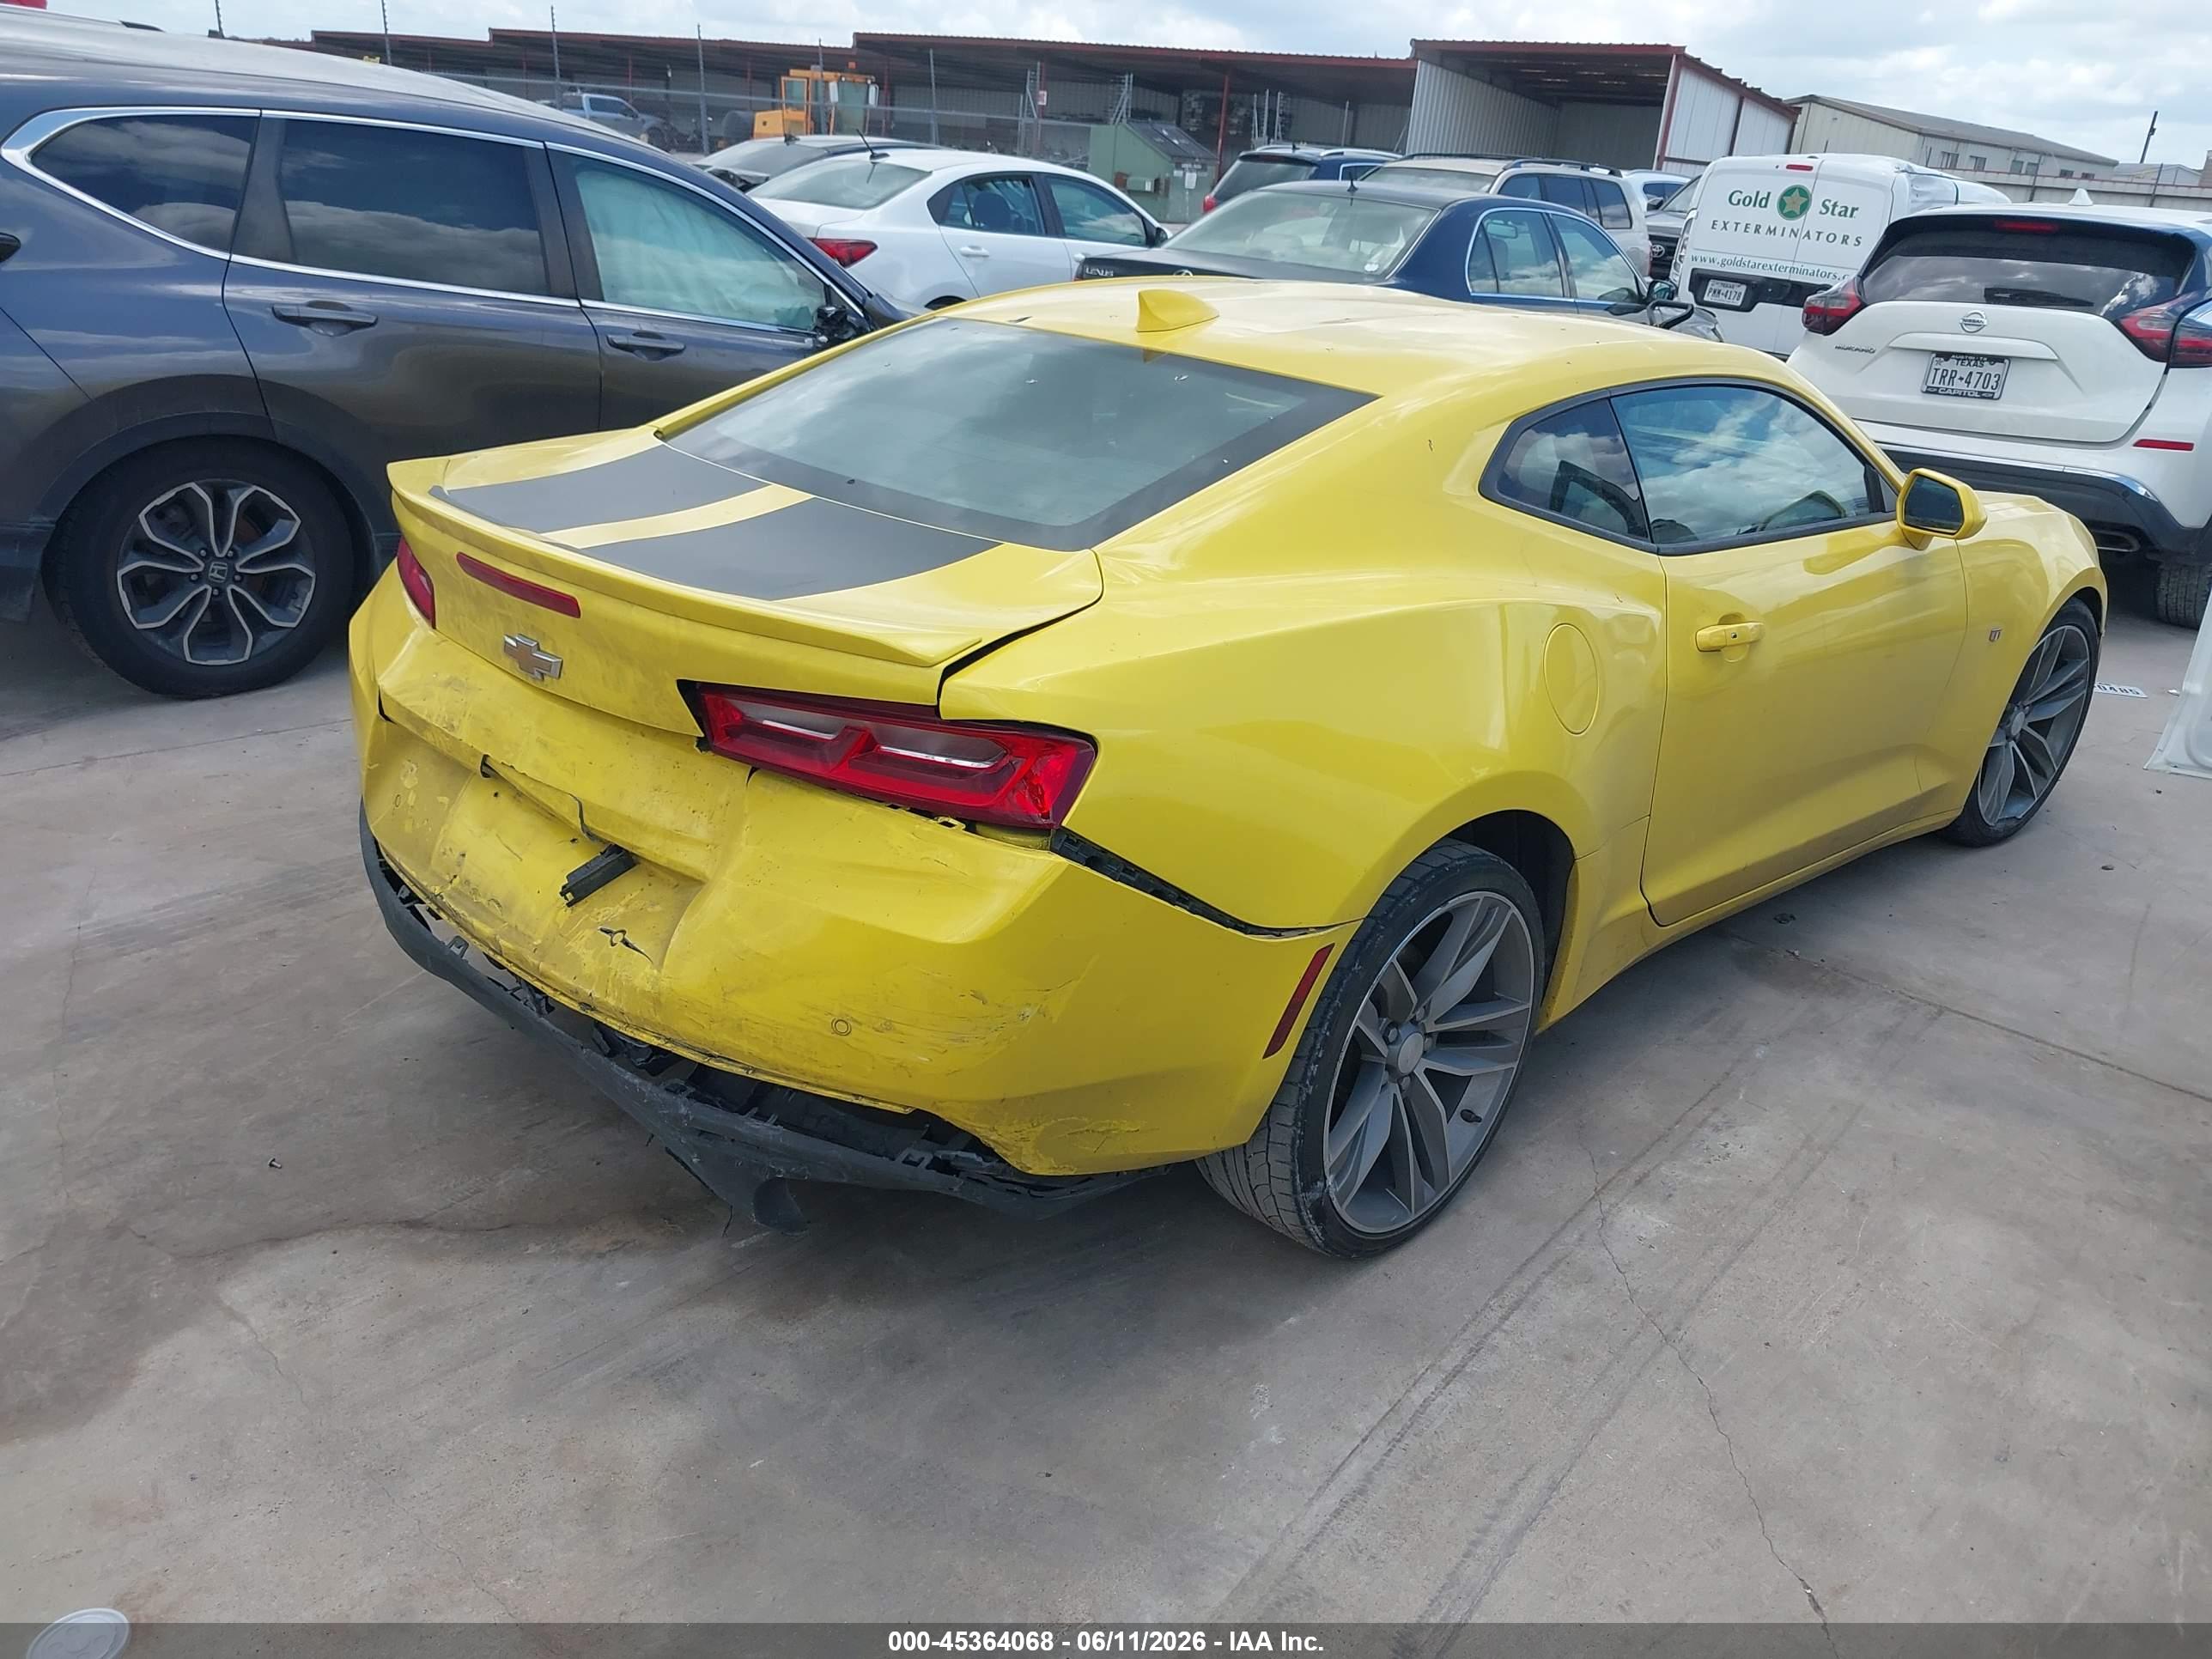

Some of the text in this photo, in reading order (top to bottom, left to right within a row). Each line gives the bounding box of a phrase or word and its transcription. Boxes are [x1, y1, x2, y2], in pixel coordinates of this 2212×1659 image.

[1728, 190, 1860, 218] Gold Star
[1711, 219, 1863, 247] EXTERMINATORS
[1954, 357, 1984, 368] TEXAS
[1938, 387, 1981, 398] CAPITOL
